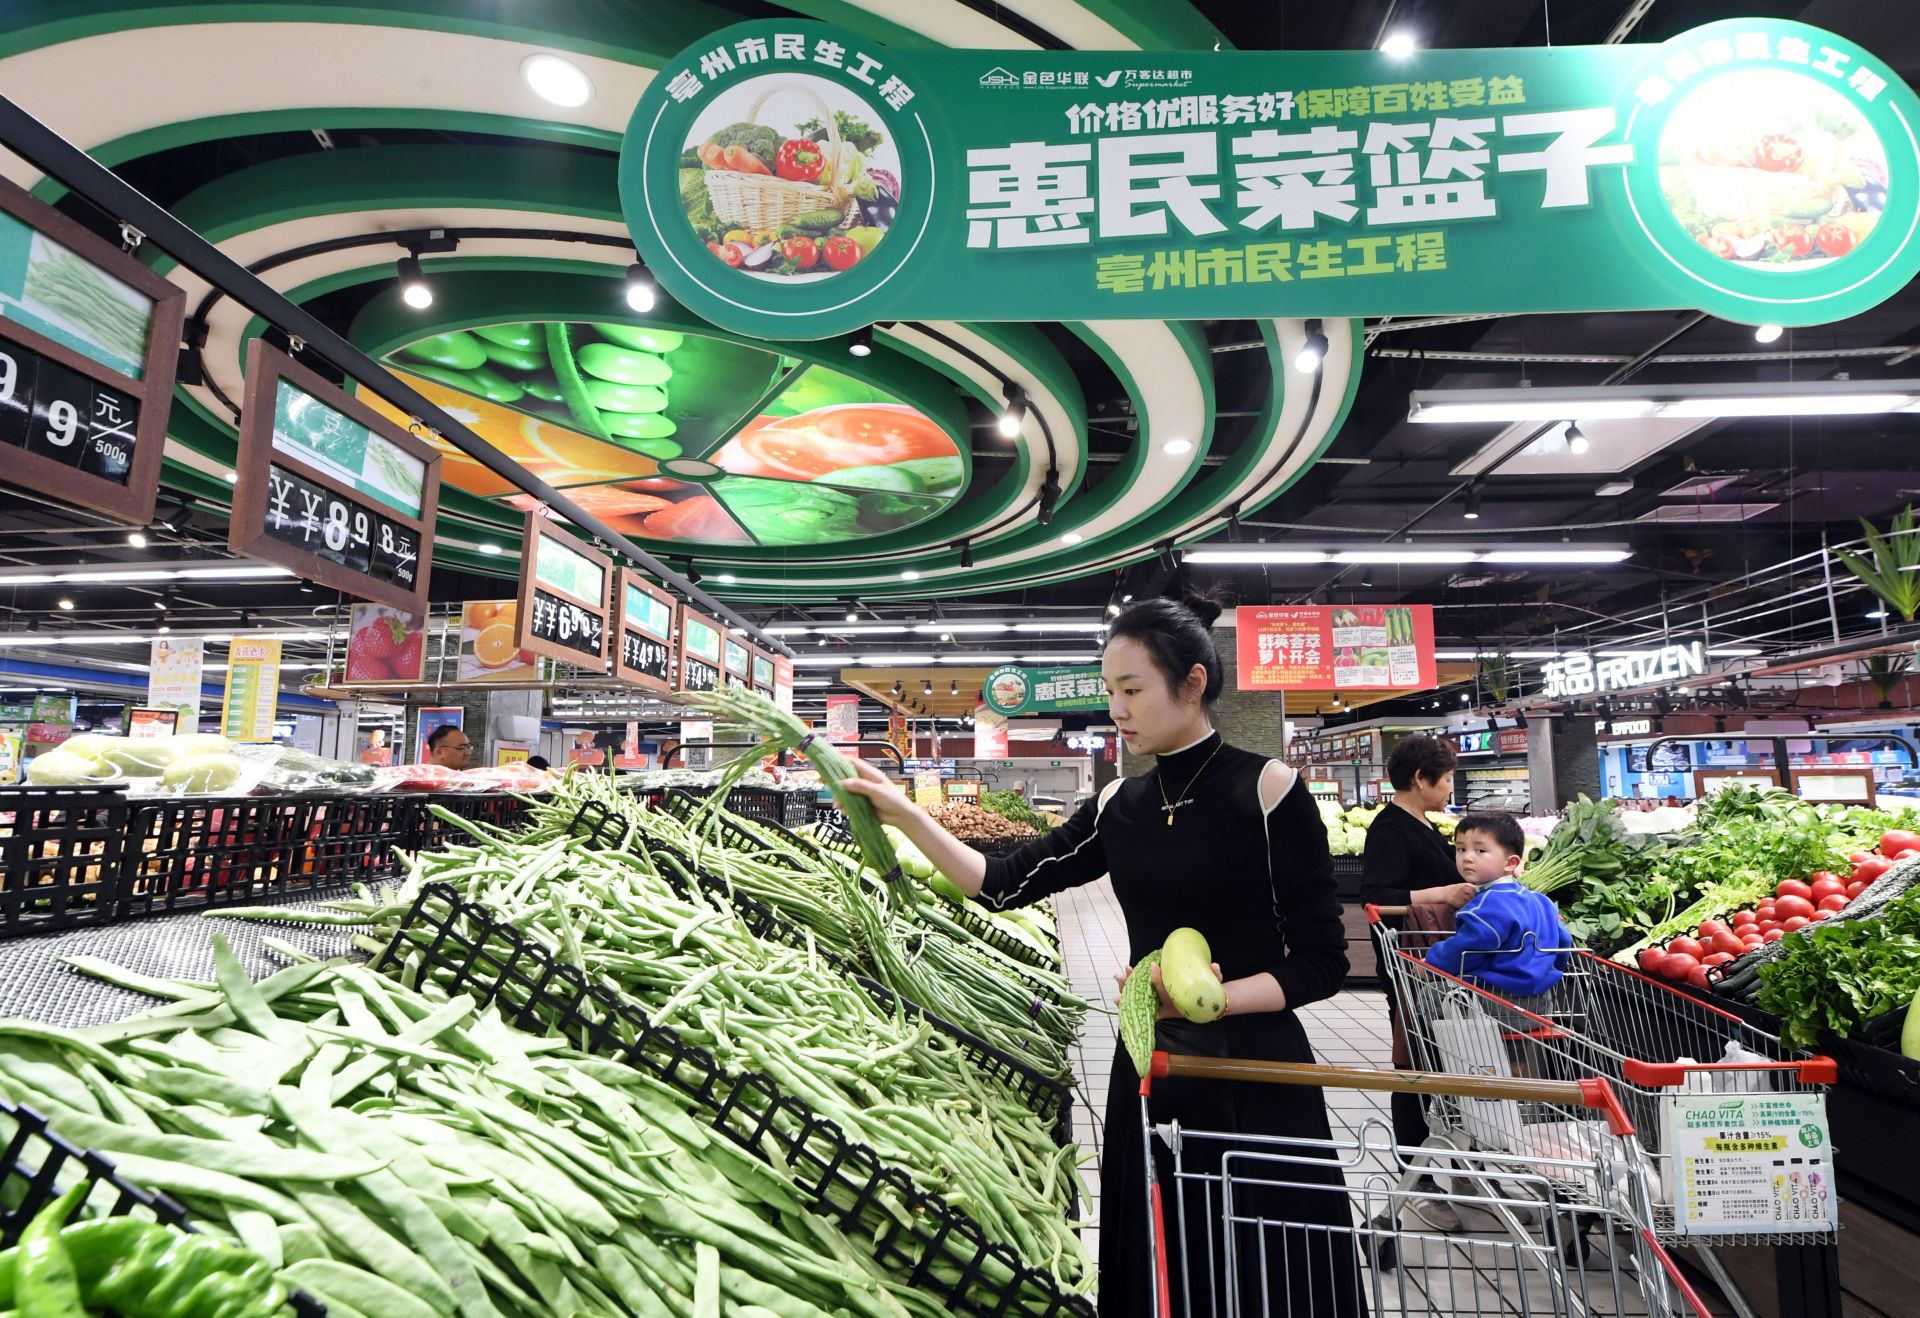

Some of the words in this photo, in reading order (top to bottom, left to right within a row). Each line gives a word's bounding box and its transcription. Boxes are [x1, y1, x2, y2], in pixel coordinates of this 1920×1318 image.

[664, 33, 916, 112] 亳州市民生工程
[1023, 71, 1089, 85] 金色华联
[1125, 70, 1192, 79] 万客达超市
[1125, 79, 1192, 90] Supermarket
[966, 107, 1634, 249] 惠民菜篮子
[1096, 231, 1447, 295] 亳州市民生工程
[46, 400, 78, 447] 9
[95, 440, 127, 465] 500g
[397, 568, 413, 582] 500g
[1258, 649, 1321, 666] 萝卜开会
[1597, 641, 1703, 692] FROZEN
[1611, 720, 1650, 736] EAFOOD
[1685, 1110, 1716, 1120] CHAO
[1719, 1110, 1744, 1119] VITA
